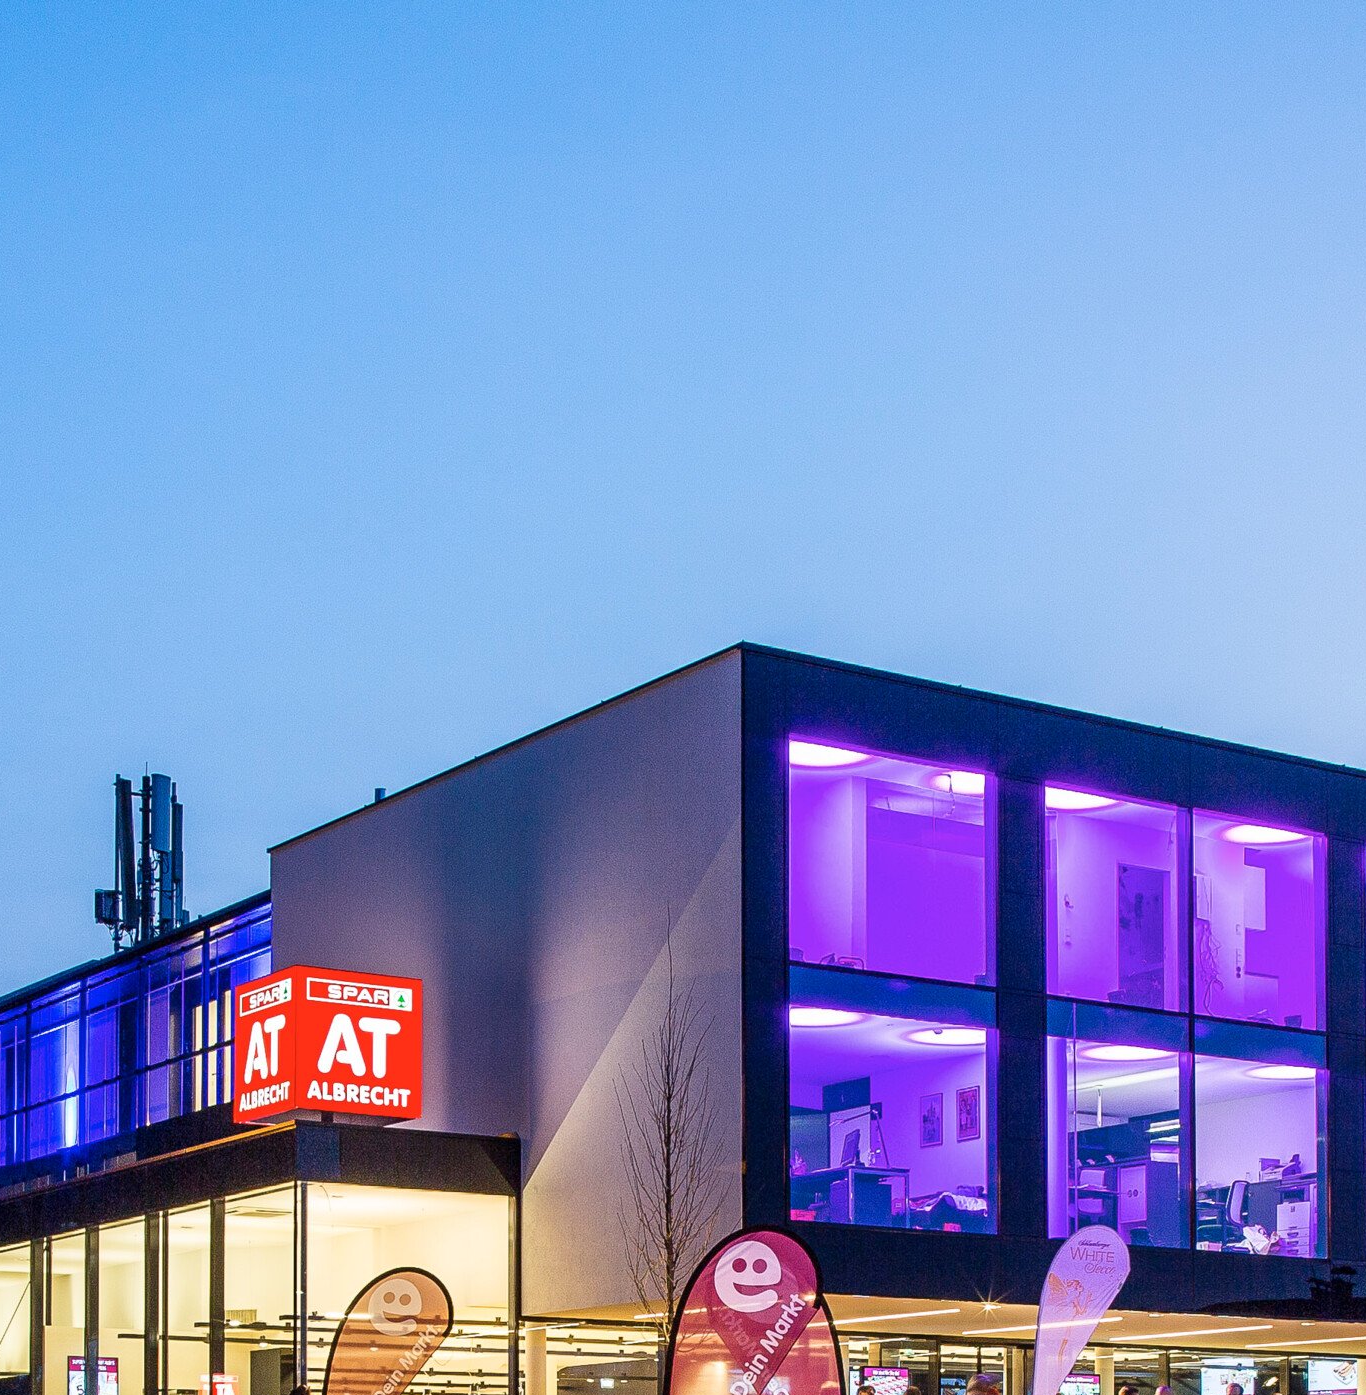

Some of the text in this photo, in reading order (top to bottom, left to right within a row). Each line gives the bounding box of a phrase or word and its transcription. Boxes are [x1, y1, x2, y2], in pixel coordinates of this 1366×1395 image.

[249, 984, 280, 1009] SPAR
[327, 984, 389, 1005] SPAR
[244, 1013, 286, 1085] AT
[317, 1013, 401, 1079] AT
[239, 1081, 291, 1112] ALBRECHT
[307, 1080, 411, 1108] ALBRECHT
[1070, 1246, 1115, 1262] WHITE
